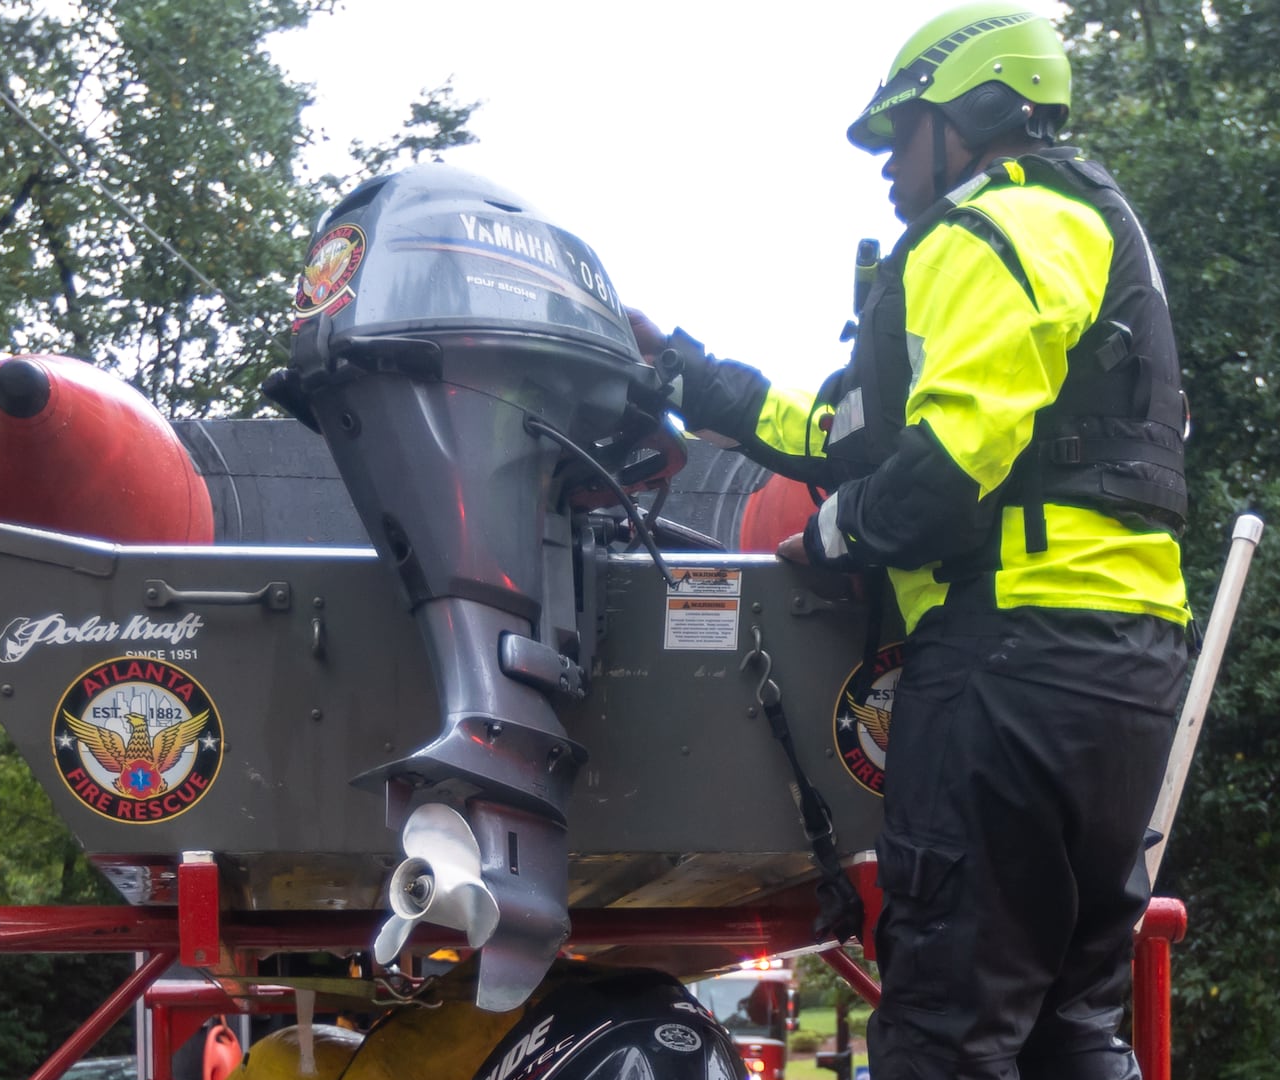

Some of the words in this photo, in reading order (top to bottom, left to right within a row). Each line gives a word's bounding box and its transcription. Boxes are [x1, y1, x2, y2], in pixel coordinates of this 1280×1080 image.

[870, 87, 916, 115] WRSI
[459, 213, 557, 268] YAMAHA
[16, 612, 121, 660] Polar
[120, 612, 205, 645] Kraft
[170, 649, 198, 660] 1951
[82, 661, 196, 702] ATLANTA
[92, 707, 122, 719] EST.
[149, 707, 182, 720] 1882
[844, 747, 886, 791] FIRE
[67, 767, 113, 812] FIRE
[117, 771, 209, 820] RESCUE
